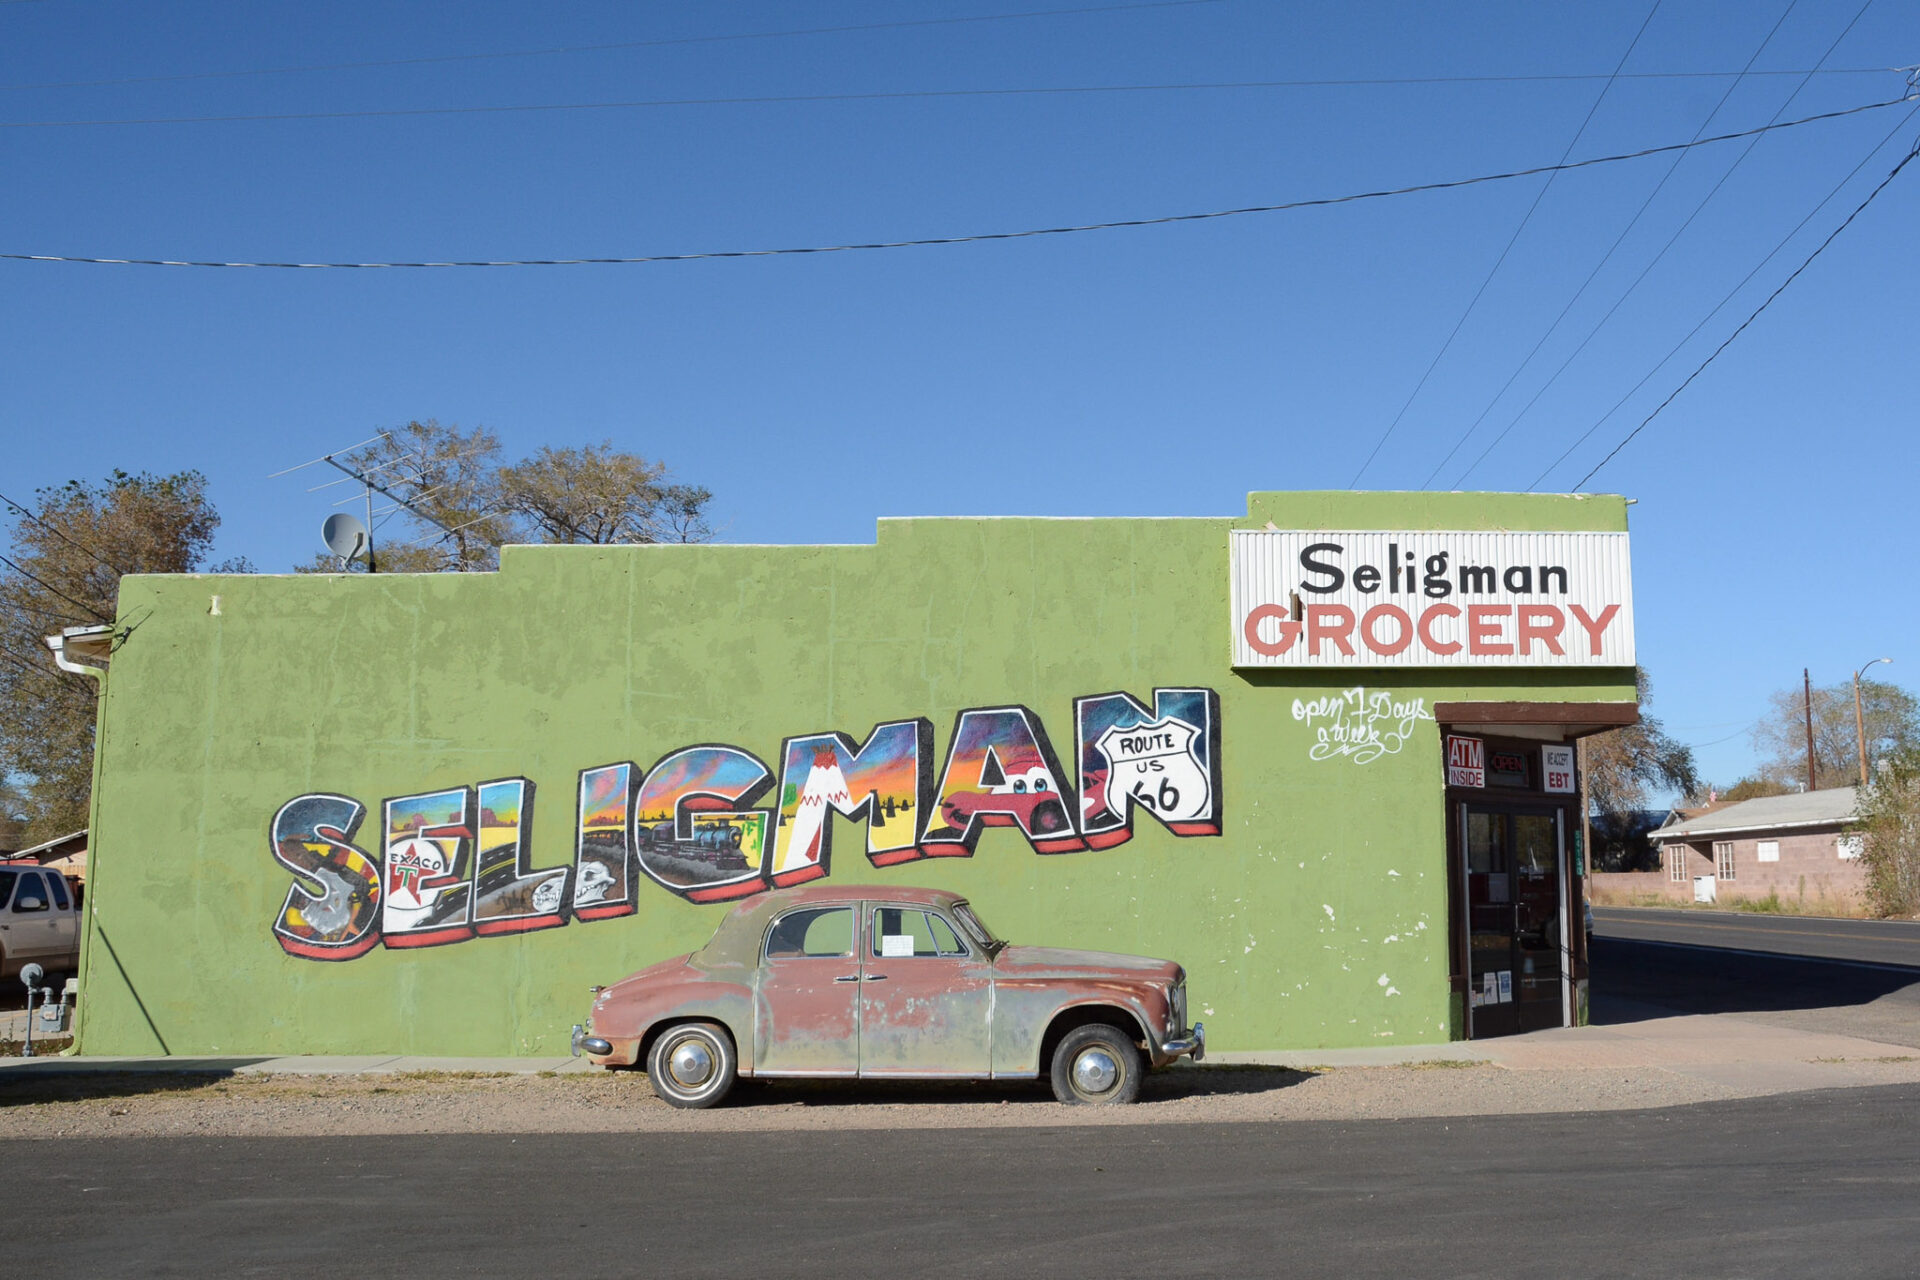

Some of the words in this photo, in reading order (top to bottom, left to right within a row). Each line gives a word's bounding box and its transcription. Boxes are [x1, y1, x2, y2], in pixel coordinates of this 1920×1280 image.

[1299, 542, 1568, 598] Seligman
[1244, 603, 1622, 657] GROCERY
[1342, 686, 1372, 725] 7
[1368, 691, 1436, 739] Days
[1120, 733, 1175, 755] ROUTE
[1317, 727, 1331, 743] a
[1450, 739, 1483, 768] ATM
[1493, 755, 1523, 771] OPEN
[1554, 752, 1569, 766] ACCEPT
[1136, 760, 1165, 773] US
[1450, 769, 1483, 786] INSIDE
[1548, 772, 1570, 789] EBT
[1132, 777, 1180, 812] 66
[269, 687, 1223, 961] SELIGMAN
[396, 866, 418, 888] T
